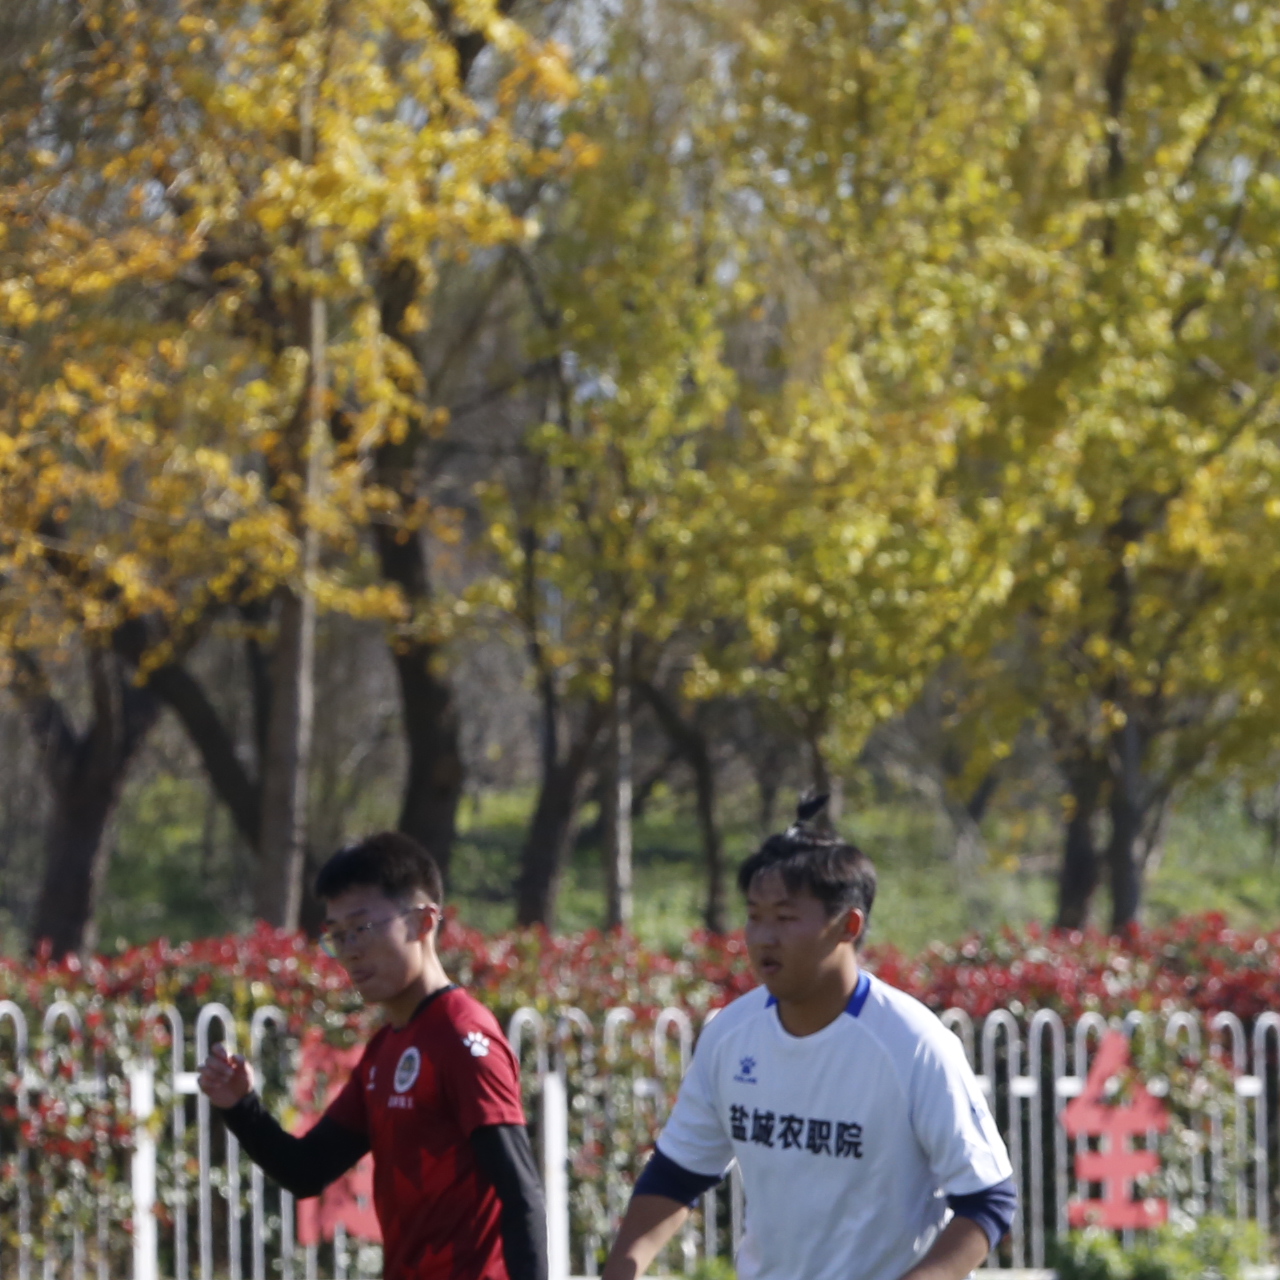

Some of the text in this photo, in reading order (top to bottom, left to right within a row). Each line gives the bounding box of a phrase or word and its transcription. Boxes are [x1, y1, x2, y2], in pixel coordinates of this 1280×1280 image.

[729, 1102, 864, 1159] 盐城农职院
